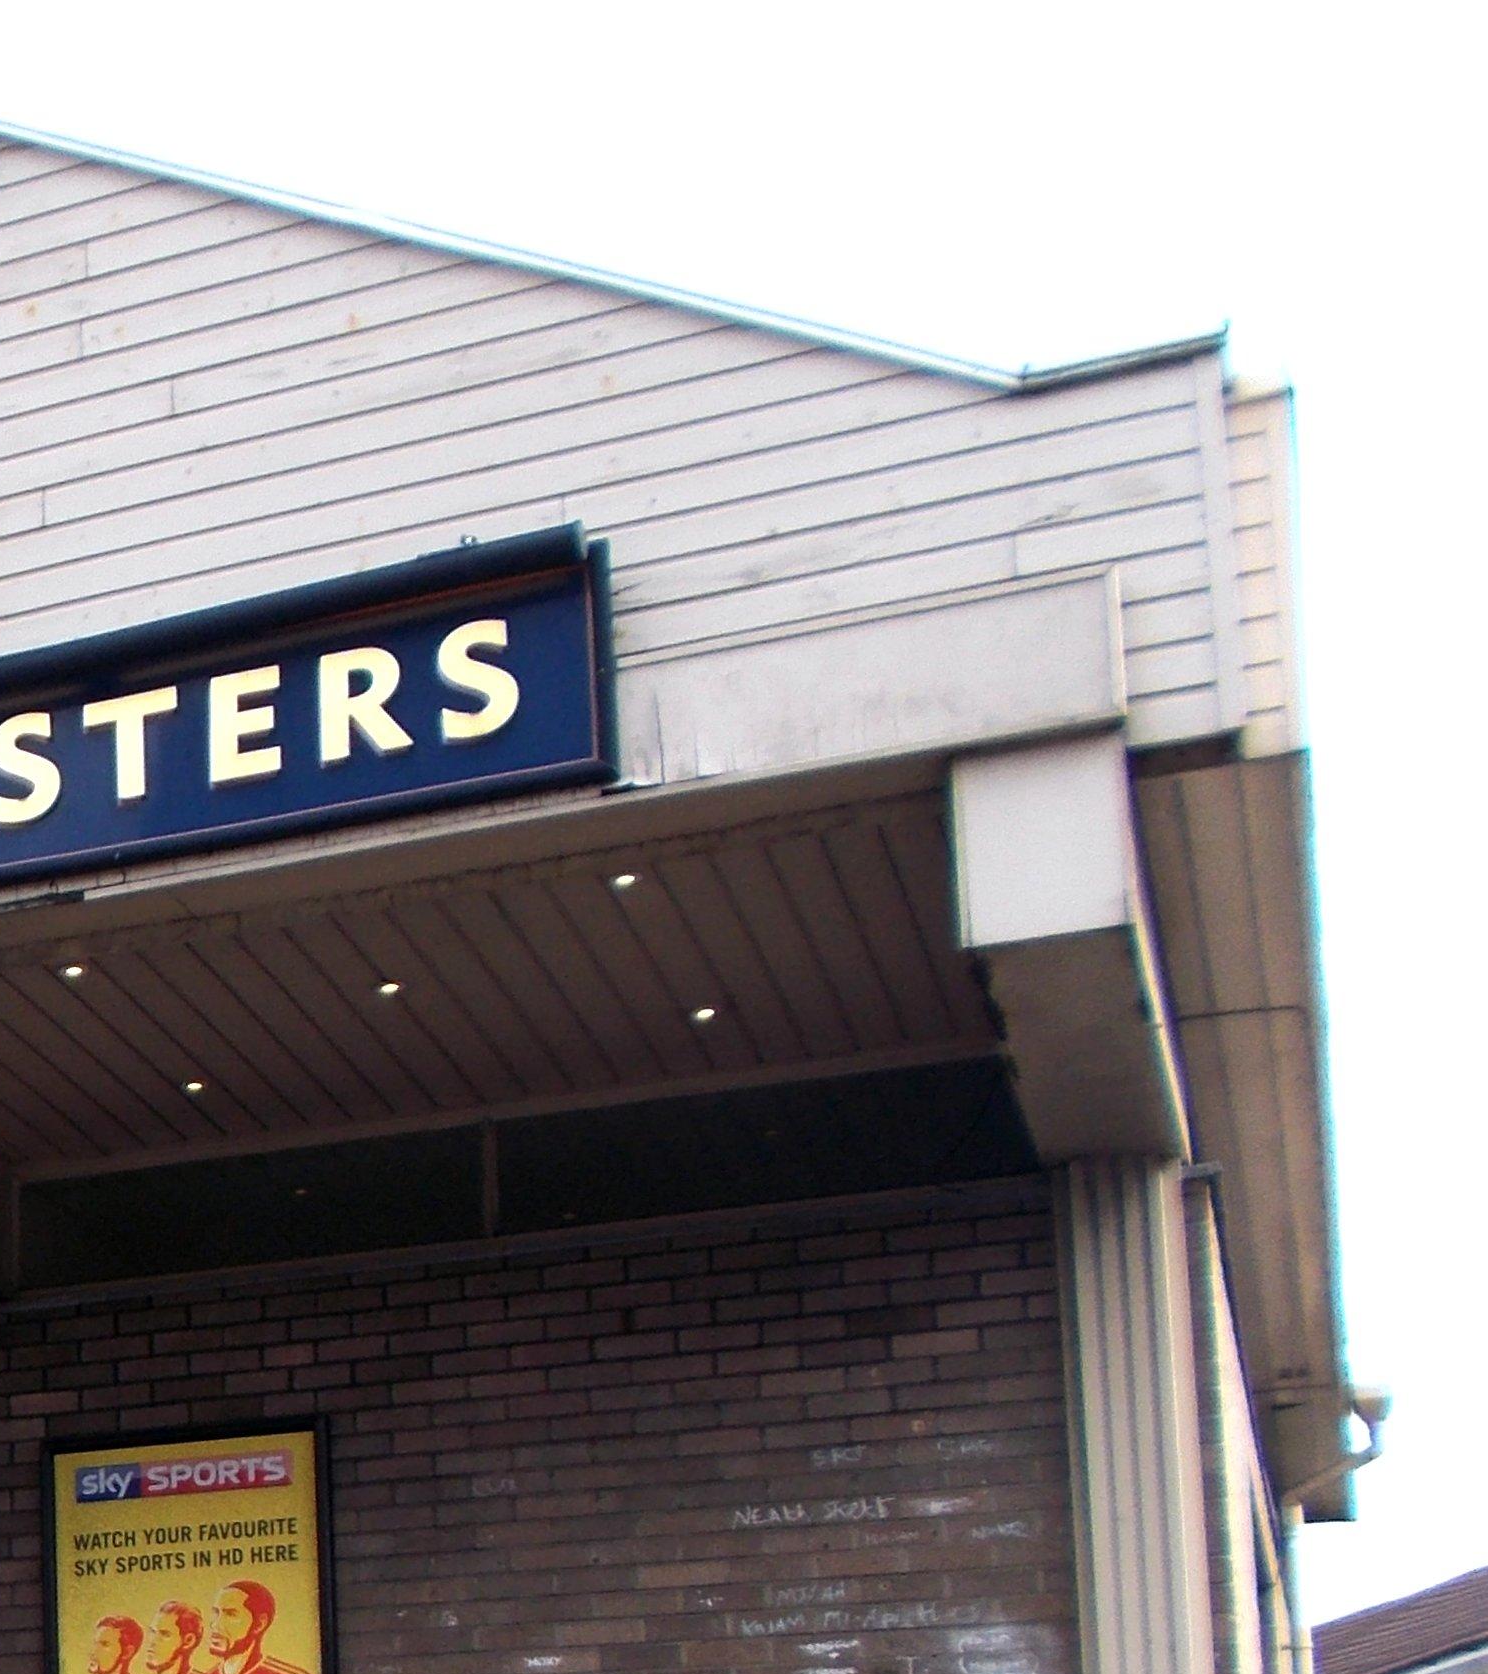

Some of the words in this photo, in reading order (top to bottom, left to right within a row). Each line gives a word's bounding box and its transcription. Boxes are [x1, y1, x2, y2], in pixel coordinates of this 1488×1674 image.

[81, 1467, 134, 1498] sky
[147, 1456, 287, 1491] SPORTS
[74, 1530, 136, 1551] WATCH
[144, 1526, 192, 1545] YOUR
[199, 1517, 298, 1541] FAVOURITE
[74, 1559, 108, 1577] SKY
[116, 1552, 185, 1573] SPORTS
[193, 1551, 211, 1567] IN
[219, 1548, 243, 1565] HD
[251, 1544, 299, 1564] HERE
